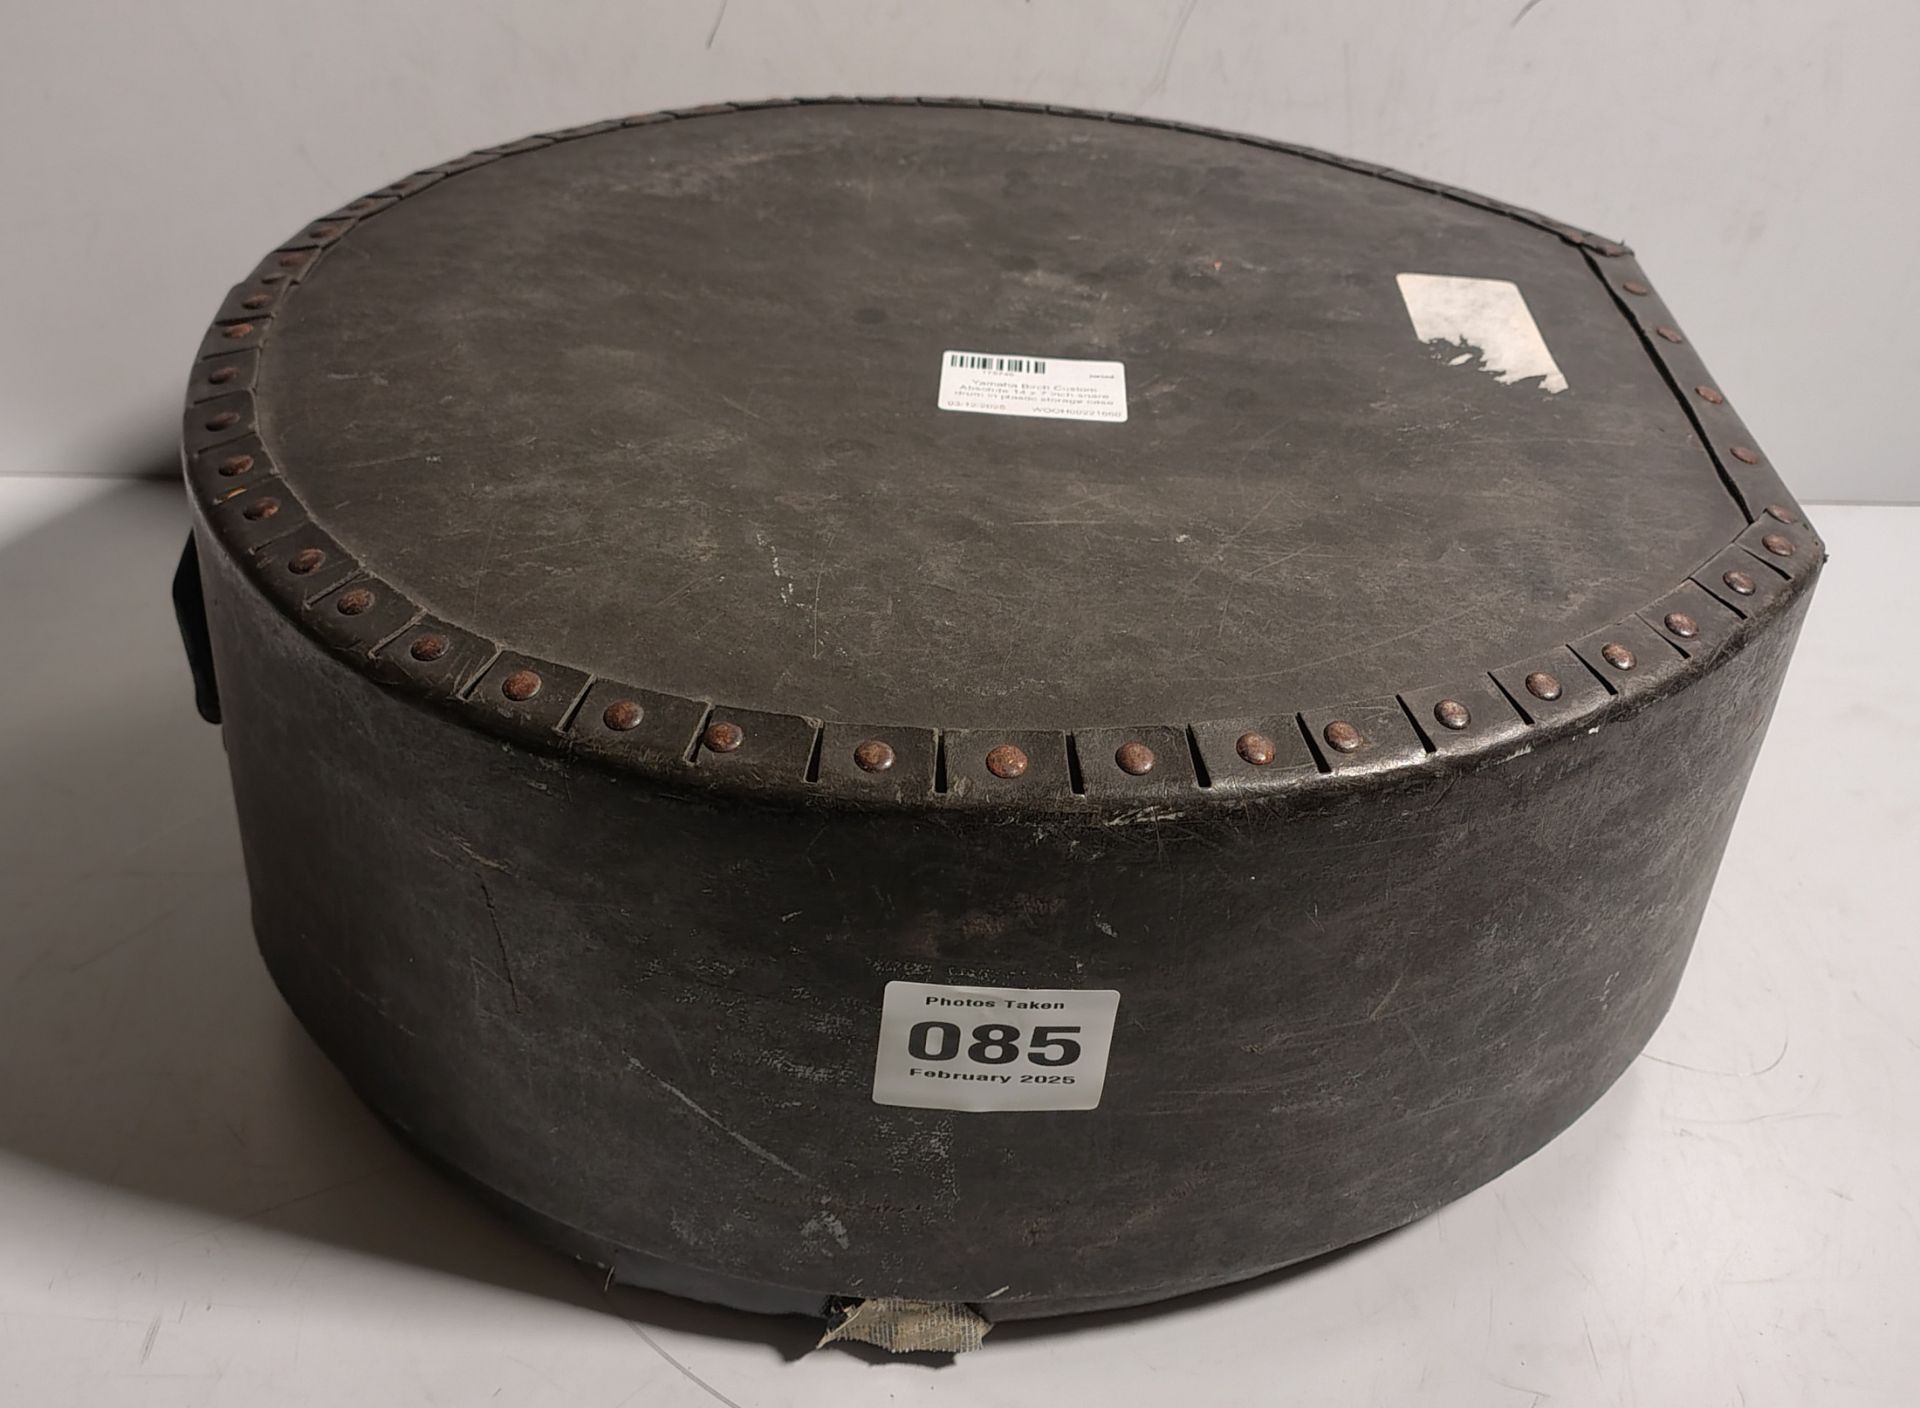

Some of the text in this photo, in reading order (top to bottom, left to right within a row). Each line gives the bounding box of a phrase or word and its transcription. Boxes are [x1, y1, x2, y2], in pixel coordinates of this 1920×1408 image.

[959, 384, 1009, 394] Absolute
[973, 379, 1018, 389] Yamaha
[1053, 384, 1098, 392] Custom
[1000, 393, 1038, 402] plastic
[1041, 395, 1083, 405] storage
[925, 996, 1065, 1010] Photos Taken
[907, 1020, 1082, 1067] 085
[909, 1067, 1076, 1085] February 2025
